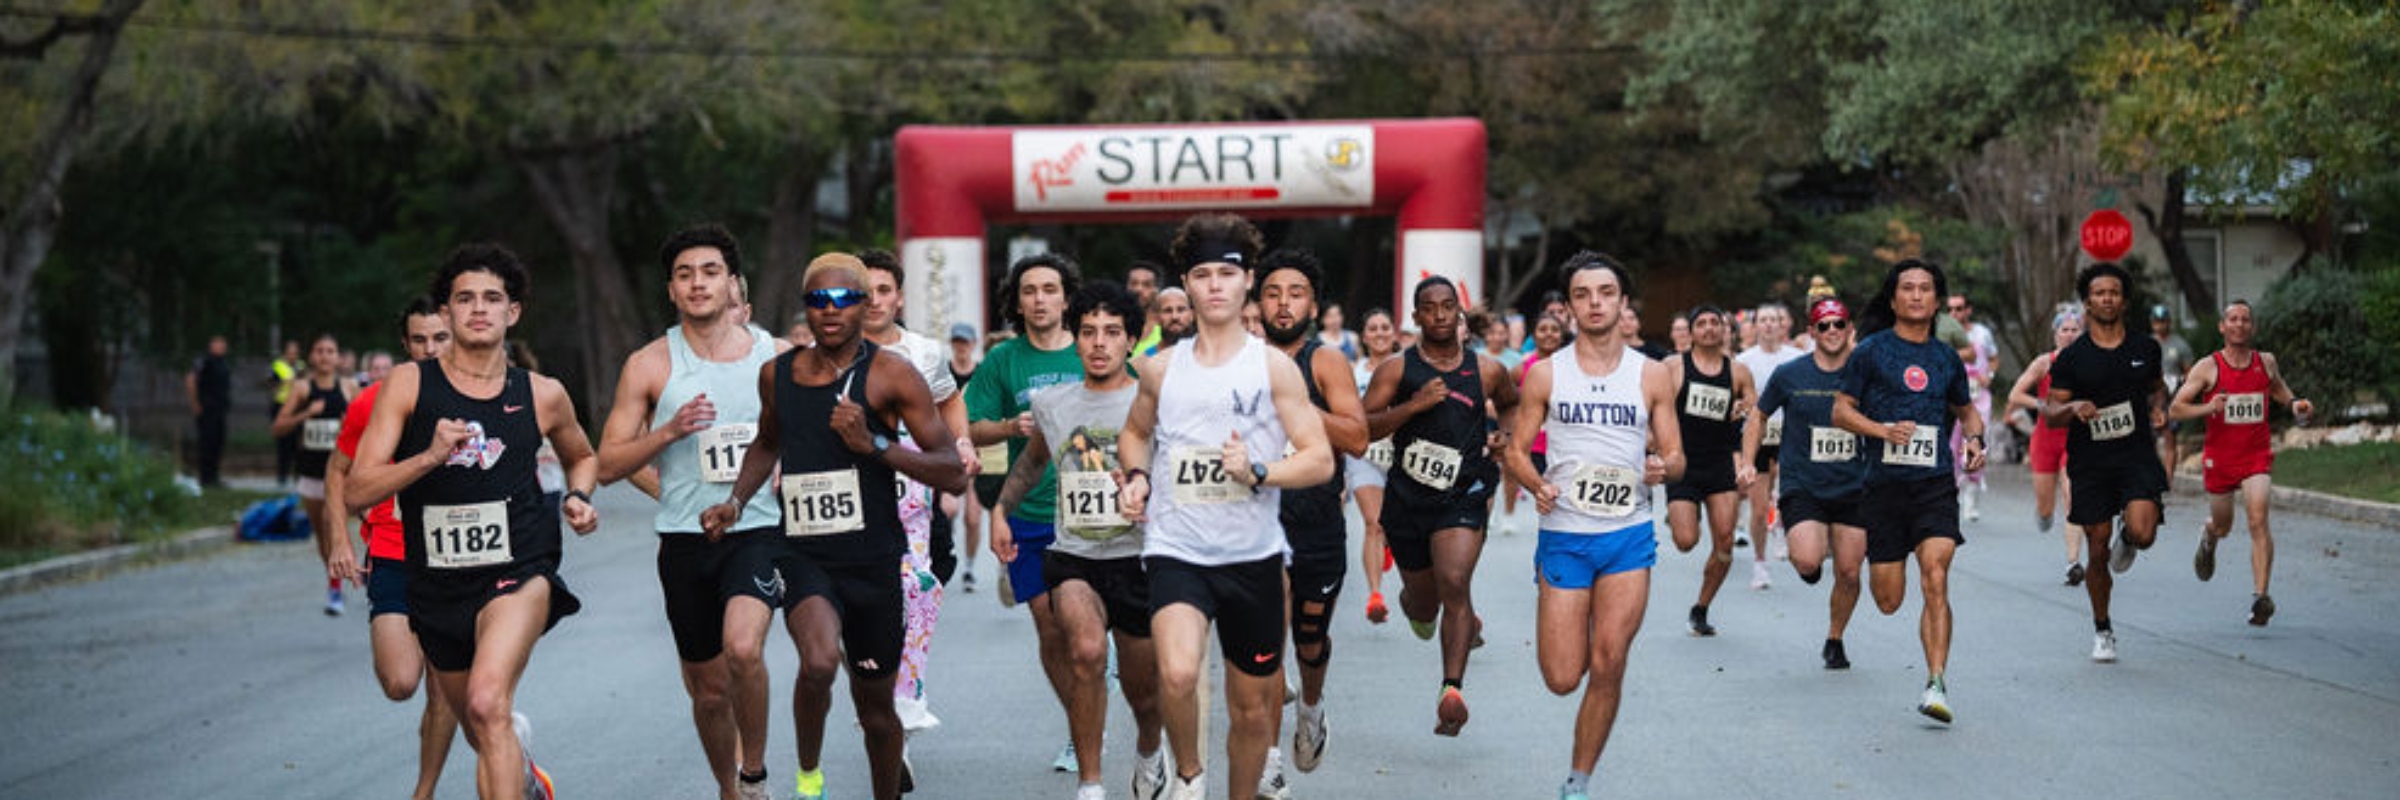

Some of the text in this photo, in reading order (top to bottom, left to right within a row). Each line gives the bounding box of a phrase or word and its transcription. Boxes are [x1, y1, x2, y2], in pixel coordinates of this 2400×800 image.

[1097, 134, 1293, 185] START
[2084, 225, 2128, 248] STOP
[1558, 403, 1637, 426] DAYTON
[2093, 414, 2132, 434] 1184
[1409, 451, 1455, 483] 1194
[1066, 490, 1121, 515] 1211
[1576, 479, 1632, 506] 1202
[789, 491, 856, 522] 1185
[430, 523, 503, 555] 1182
